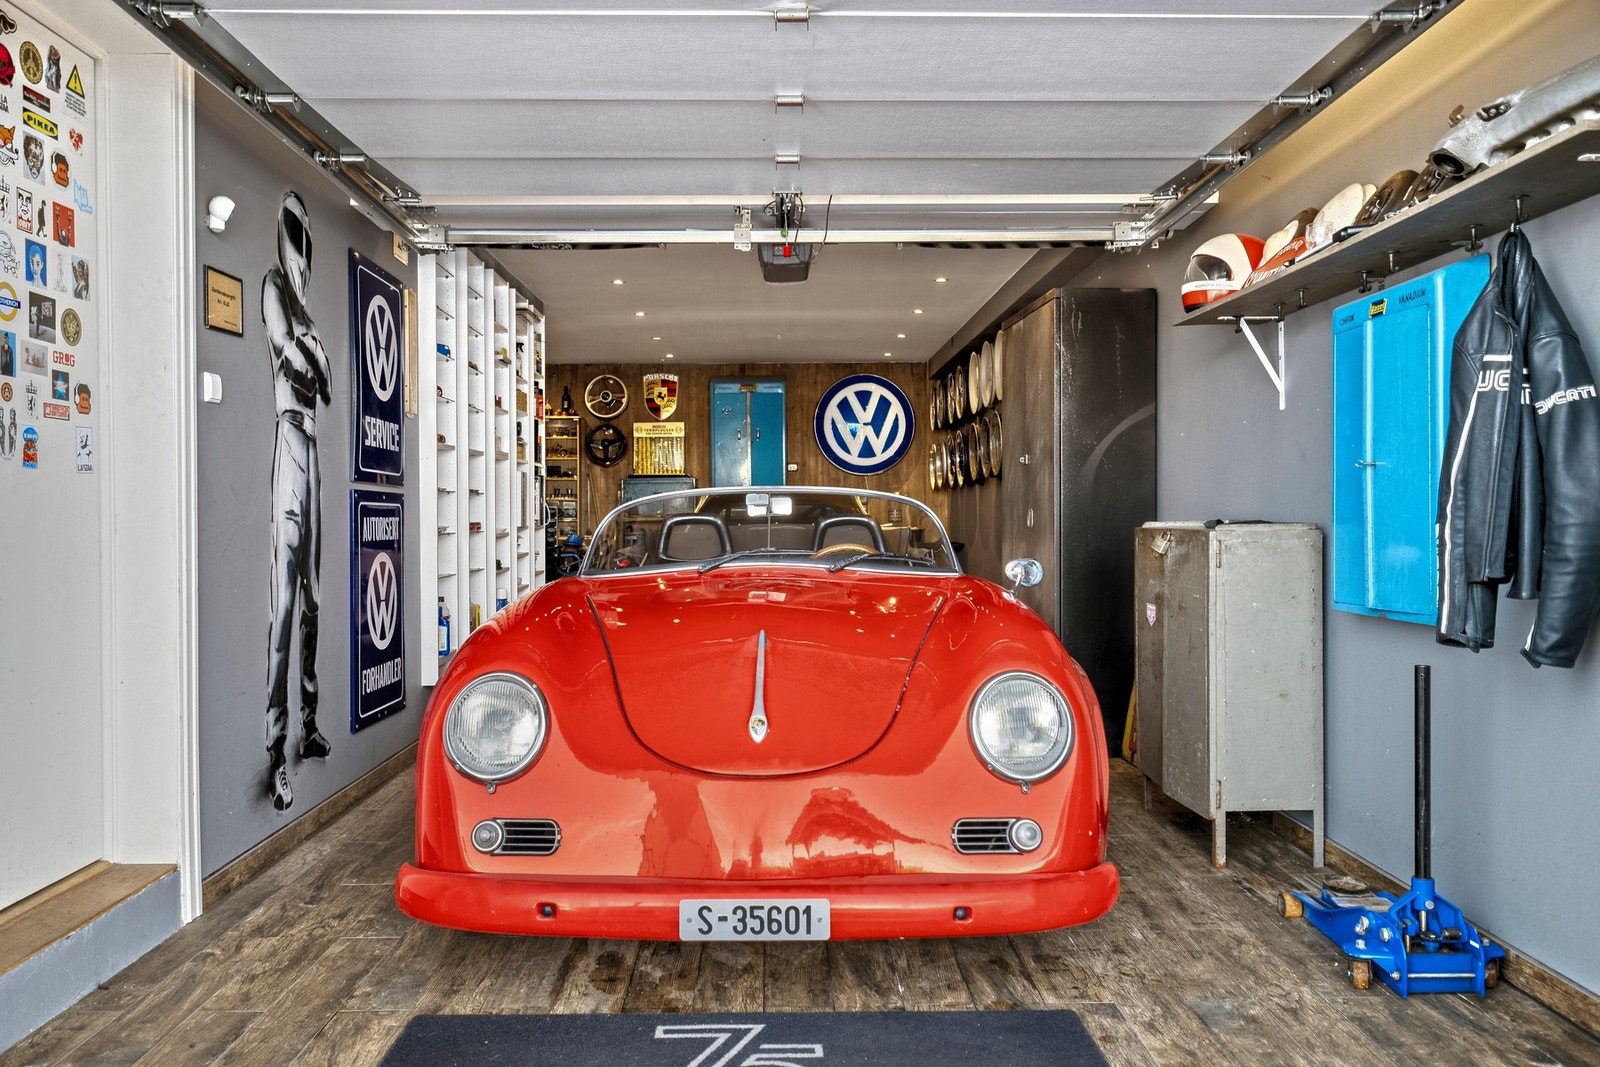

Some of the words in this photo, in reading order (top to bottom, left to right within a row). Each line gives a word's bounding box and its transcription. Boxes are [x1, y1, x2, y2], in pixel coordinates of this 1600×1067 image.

[26, 114, 56, 135] PIKEA
[1398, 288, 1427, 304] VANADIUM
[643, 373, 679, 383] PORSCHE
[364, 414, 400, 452] SERVICE
[823, 382, 906, 467] VW
[362, 516, 400, 543] AUTORISERT
[362, 657, 402, 695] FORHANDLER
[697, 905, 812, 936] S-35601
